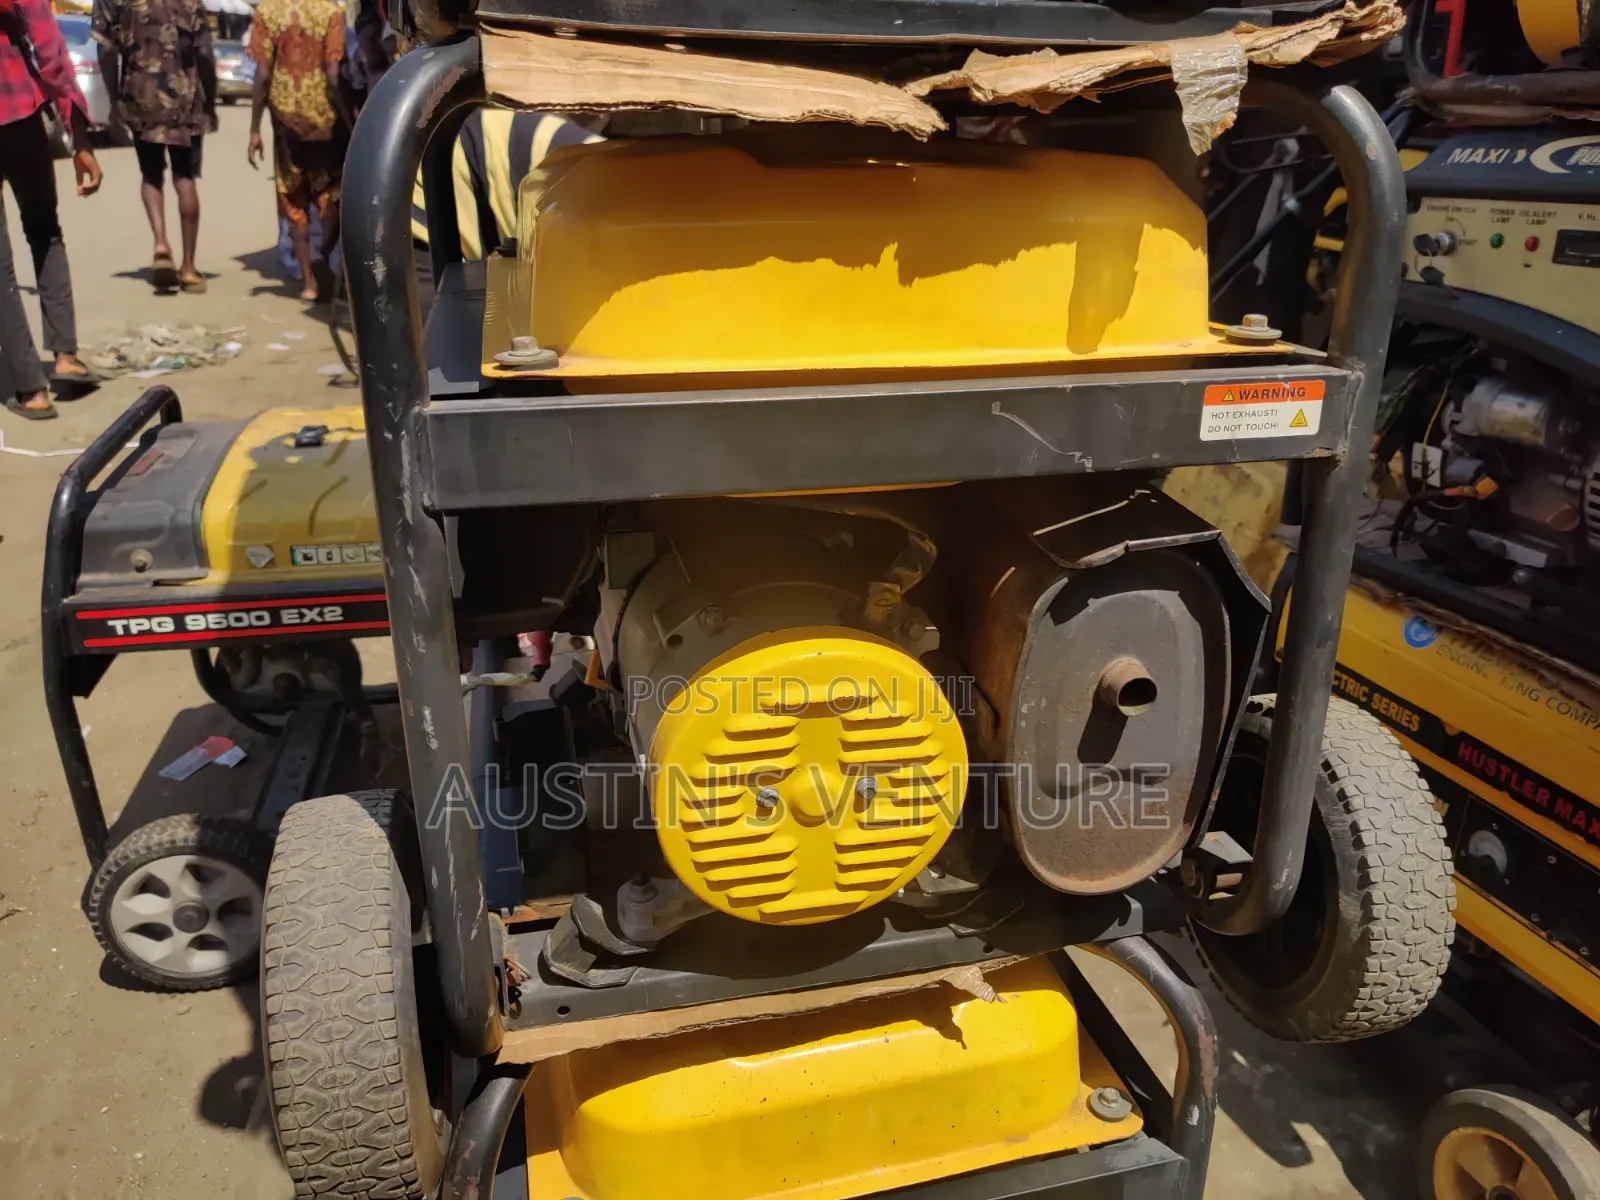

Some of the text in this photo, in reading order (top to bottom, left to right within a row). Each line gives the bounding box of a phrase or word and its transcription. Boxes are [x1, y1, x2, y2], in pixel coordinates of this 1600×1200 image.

[1447, 148, 1509, 164] MAXI
[1490, 208, 1515, 216] POWER
[1239, 387, 1306, 400] WARNING
[1211, 409, 1278, 420] HOT EXHAUST!
[1207, 422, 1279, 433] DO NOT TOUCH!
[108, 606, 344, 635] TPG 9500 EX2
[1332, 670, 1420, 732] CTRIC SERIES
[1458, 741, 1551, 808] HUSTLER
